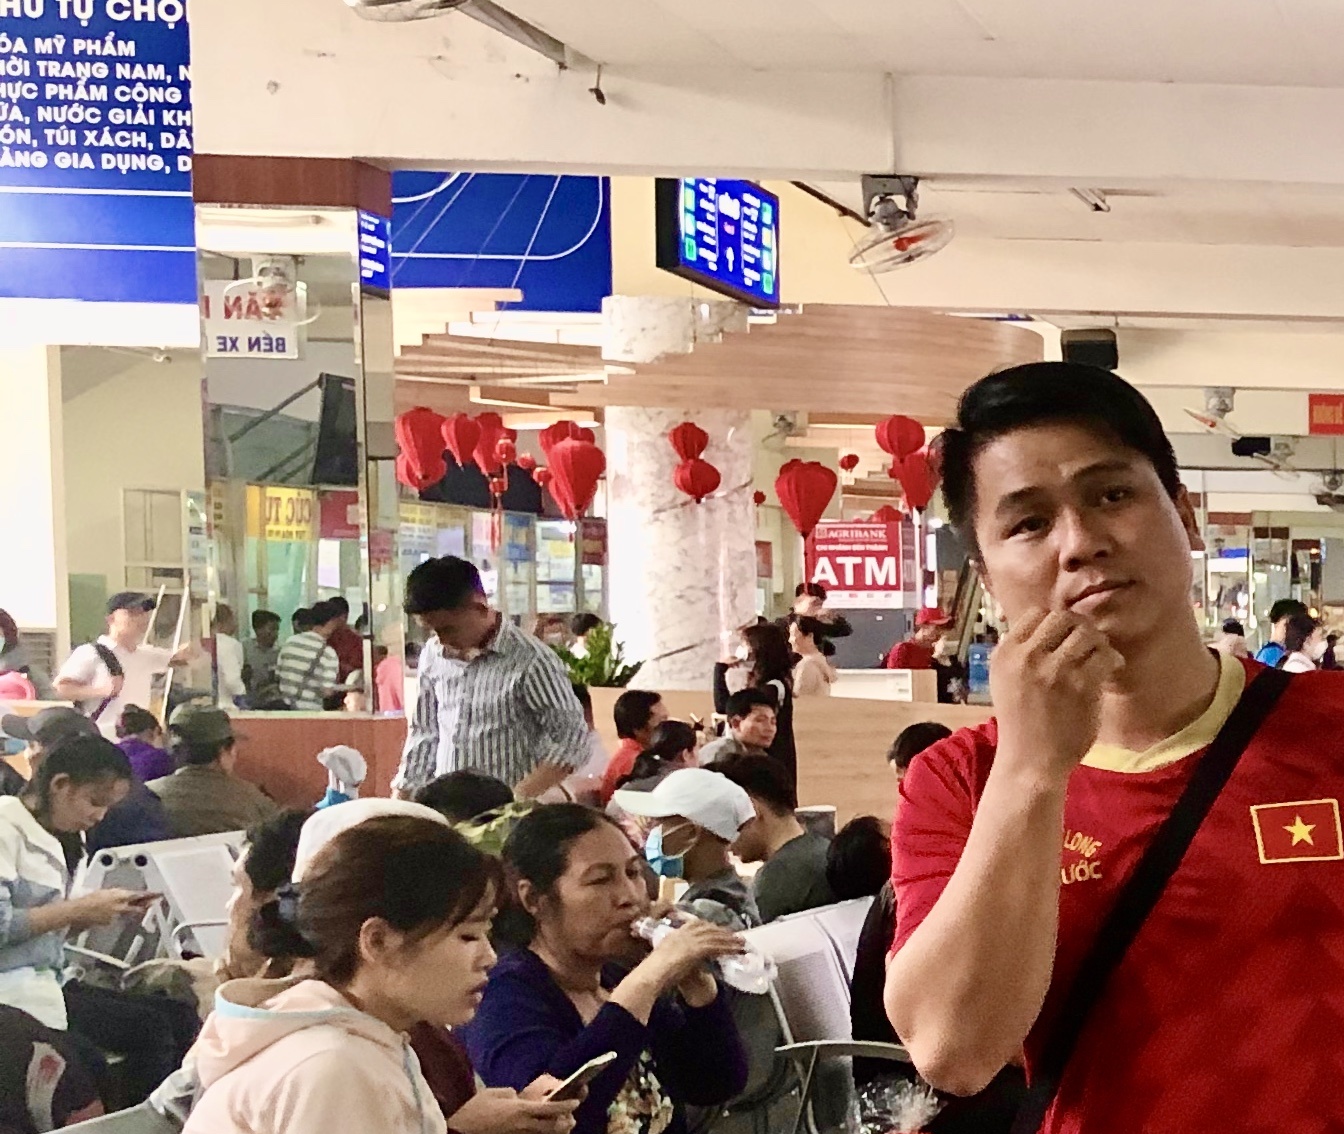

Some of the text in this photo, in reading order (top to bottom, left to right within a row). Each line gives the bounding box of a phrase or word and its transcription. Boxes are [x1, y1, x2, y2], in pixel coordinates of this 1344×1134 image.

[34, 34, 66, 55] MỸ
[73, 31, 136, 57] PHẨM
[37, 61, 109, 79] TRANG
[115, 63, 172, 84] NAM,
[45, 79, 108, 102] PHẨM
[114, 82, 182, 104] CÔNG
[37, 102, 101, 124] NƯỚC
[108, 104, 155, 125] GIẢI
[44, 125, 76, 146] TÚI
[83, 126, 154, 151] XÁCH,
[54, 151, 95, 169] GIA
[101, 153, 171, 174] DỤNG,
[828, 529, 888, 540] AGRIBANK
[812, 556, 897, 586] ATM
